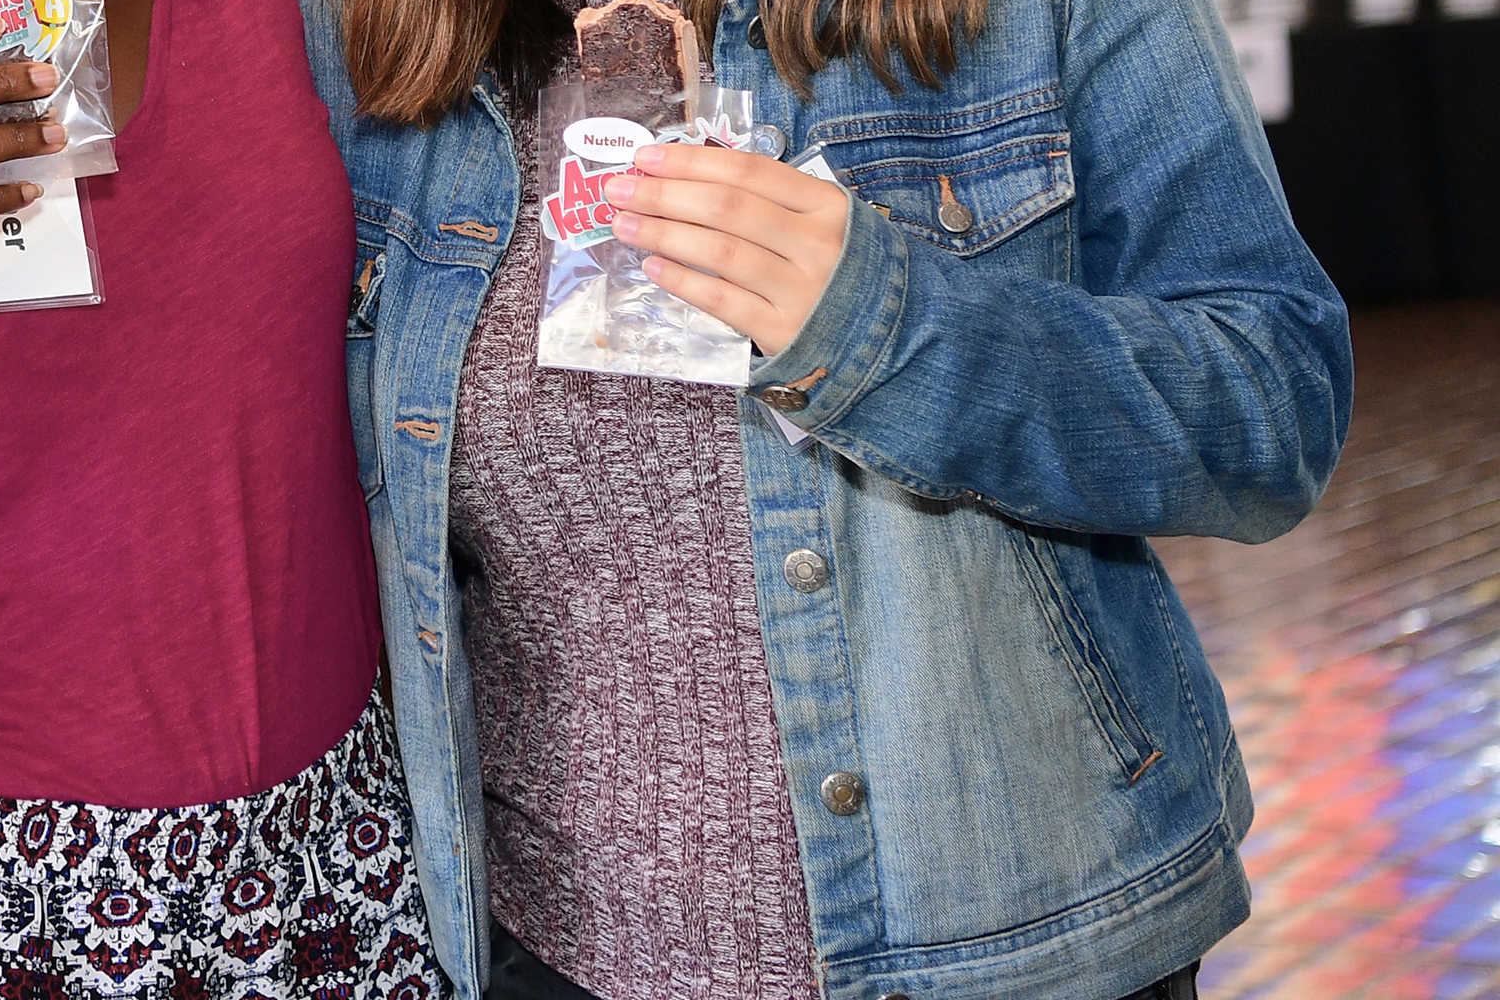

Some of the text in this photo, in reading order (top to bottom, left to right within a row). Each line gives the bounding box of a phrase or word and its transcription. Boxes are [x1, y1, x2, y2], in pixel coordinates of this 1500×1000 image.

[583, 134, 634, 148] Nutella
[2, 211, 25, 251] er
[547, 196, 595, 241] ICE
